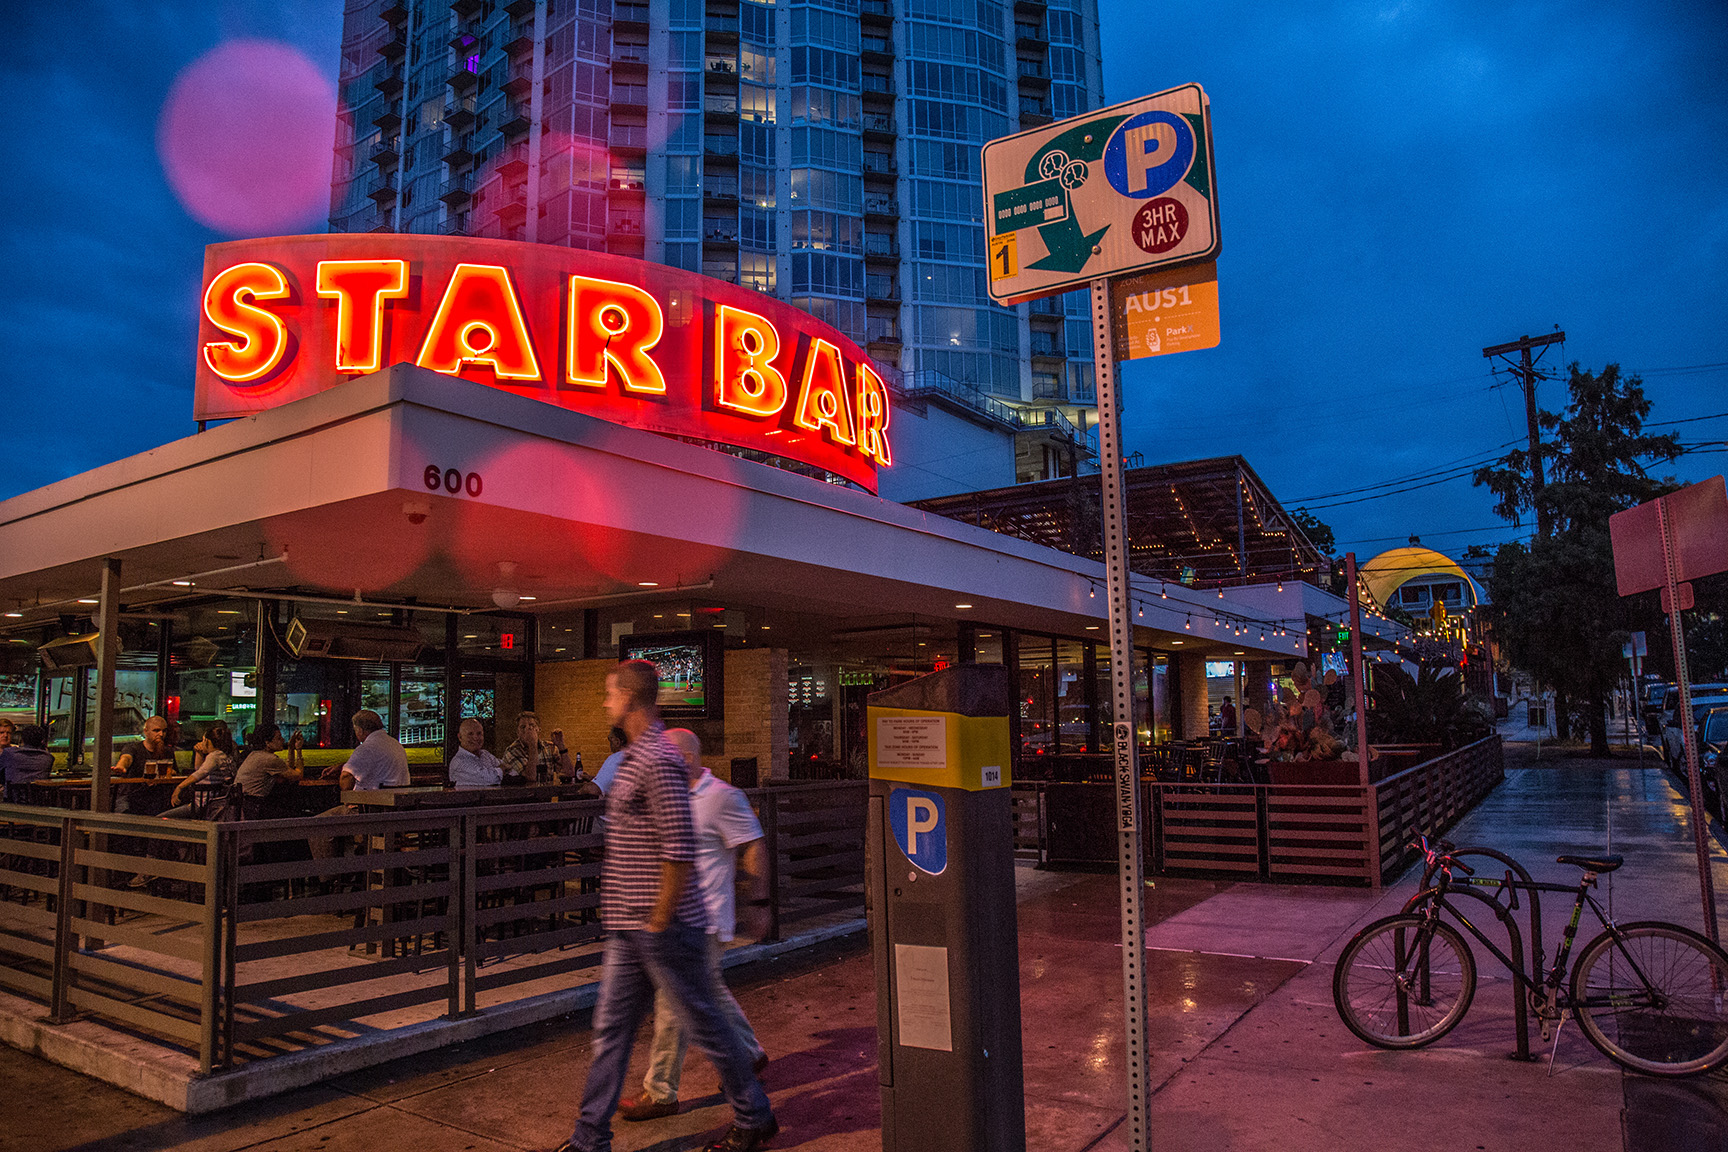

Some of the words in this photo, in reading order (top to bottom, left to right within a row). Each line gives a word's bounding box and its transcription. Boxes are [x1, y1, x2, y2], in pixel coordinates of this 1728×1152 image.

[1125, 122, 1178, 194] P
[1142, 203, 1177, 228] 3HR
[1141, 221, 1181, 249] MAX
[996, 244, 1010, 275] 1
[1123, 284, 1193, 316] AUS1
[203, 259, 667, 395] STAR
[714, 303, 892, 467] BAR
[424, 464, 483, 498] 600
[1117, 741, 1129, 774] BLACK
[1119, 774, 1132, 803] SWAN
[906, 796, 939, 855] P
[1121, 803, 1133, 829] YOGA
